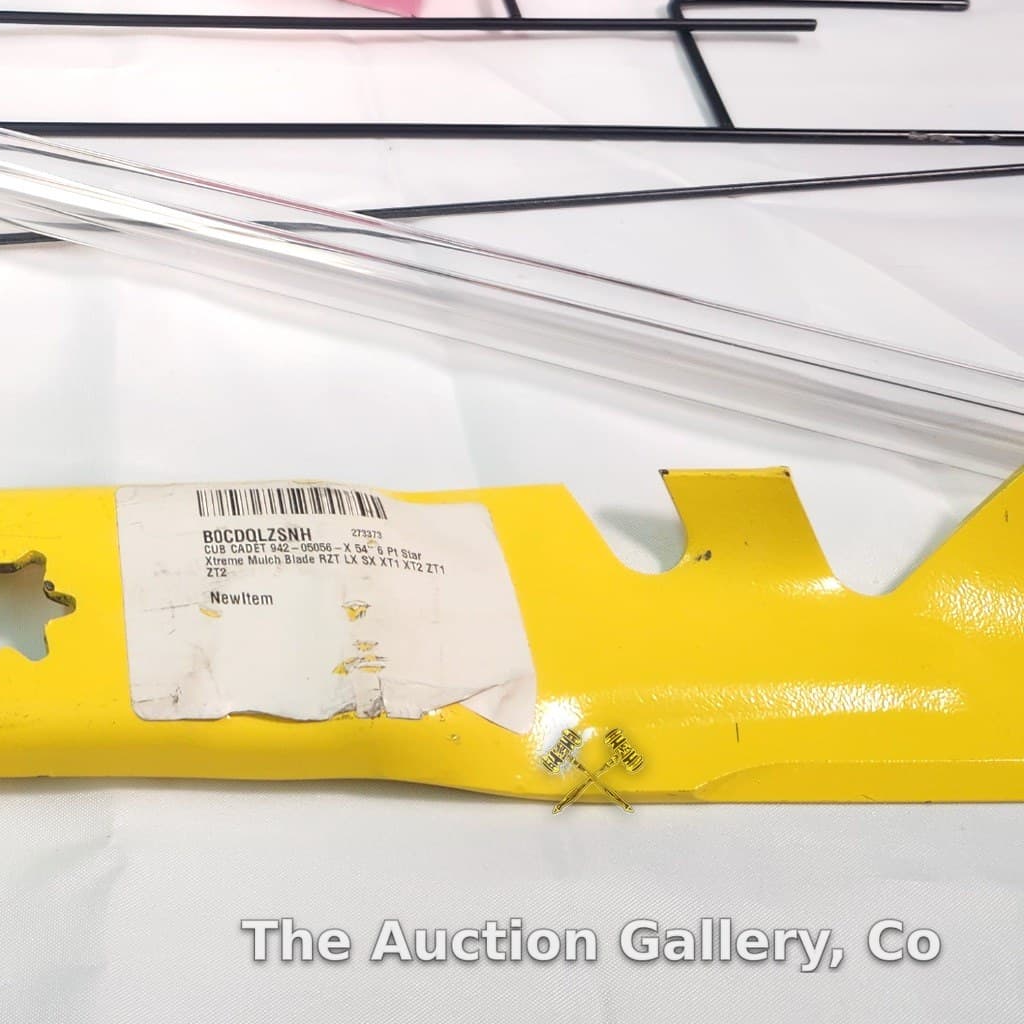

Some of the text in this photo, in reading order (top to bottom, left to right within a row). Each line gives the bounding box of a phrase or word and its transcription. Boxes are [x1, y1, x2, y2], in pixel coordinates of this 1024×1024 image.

[351, 528, 383, 540] 273373
[204, 543, 226, 554] CUB
[230, 543, 266, 554] CADET
[377, 545, 384, 556] 6
[387, 546, 398, 557] Pt
[400, 549, 422, 561] Star
[205, 554, 446, 575] Xtreme Mulch Blade RZT LX SX XT1 XT2 ZT1
[207, 567, 227, 577] ZT2
[210, 591, 273, 606] NewItem
